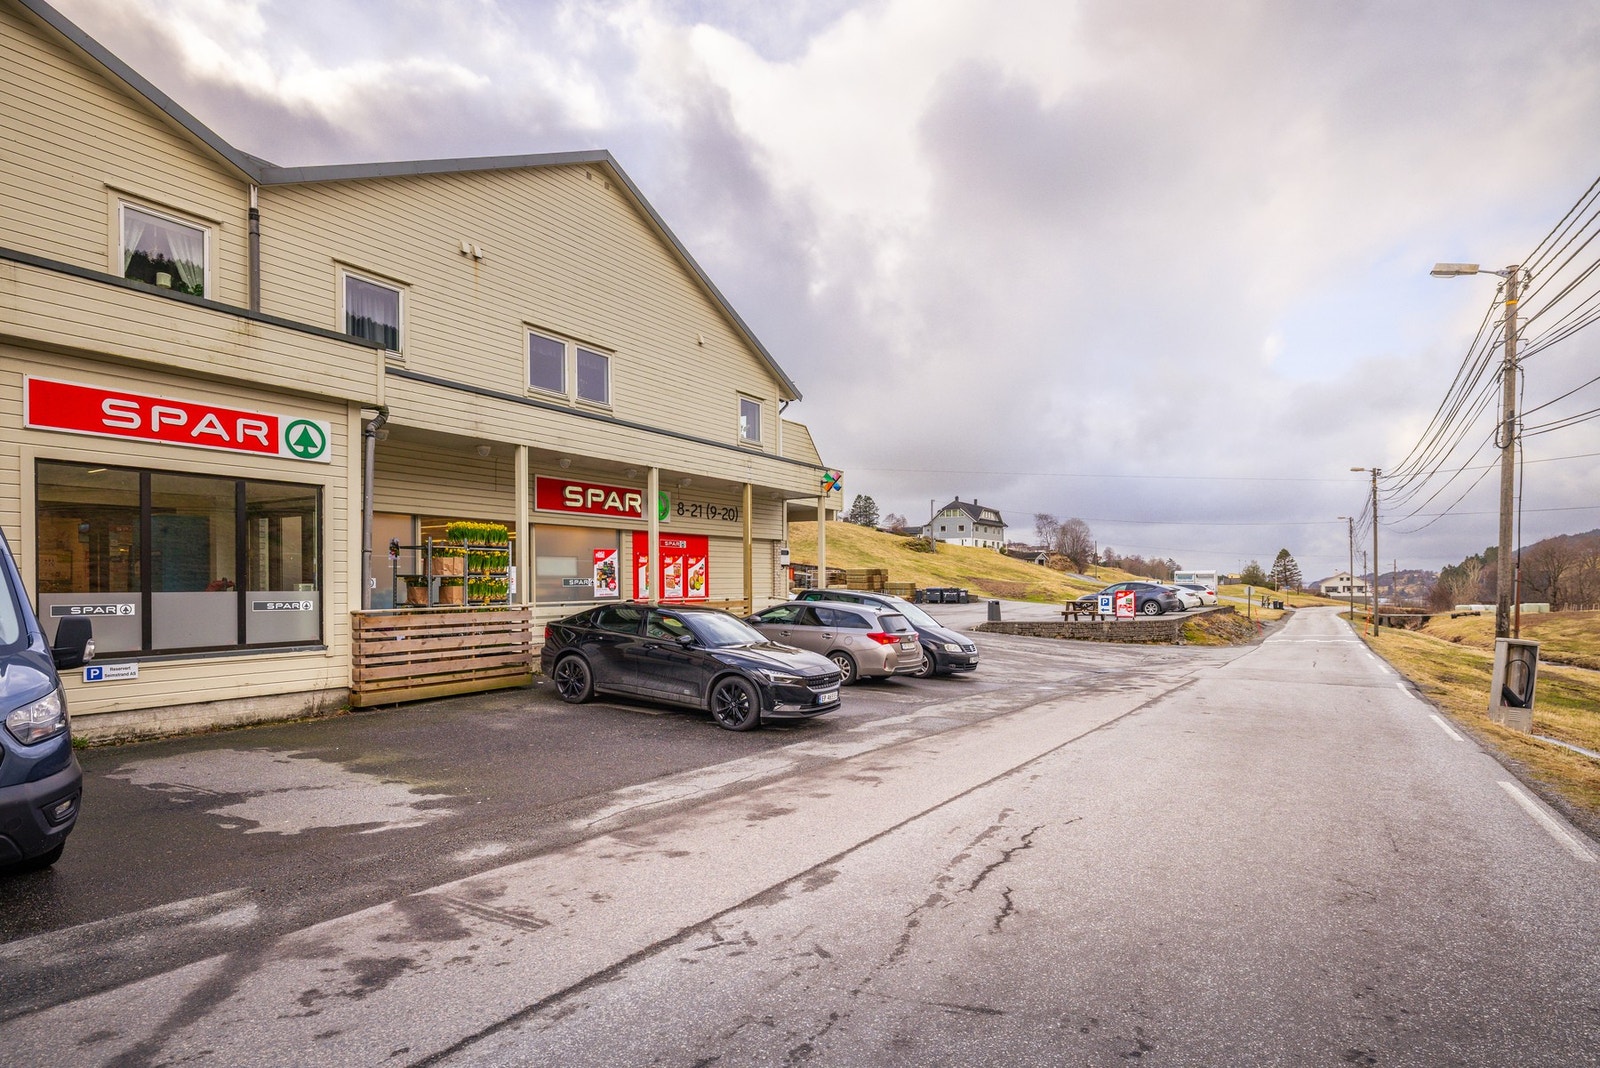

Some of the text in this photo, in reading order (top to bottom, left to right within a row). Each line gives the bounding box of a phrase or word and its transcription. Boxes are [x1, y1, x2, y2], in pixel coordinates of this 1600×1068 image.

[101, 398, 269, 446] SPAR
[563, 485, 642, 513] SPAR
[677, 502, 739, 523] 8-21 (9-20)
[70, 606, 116, 615] SPAR
[266, 602, 300, 610] SPAR
[90, 668, 100, 679] P
